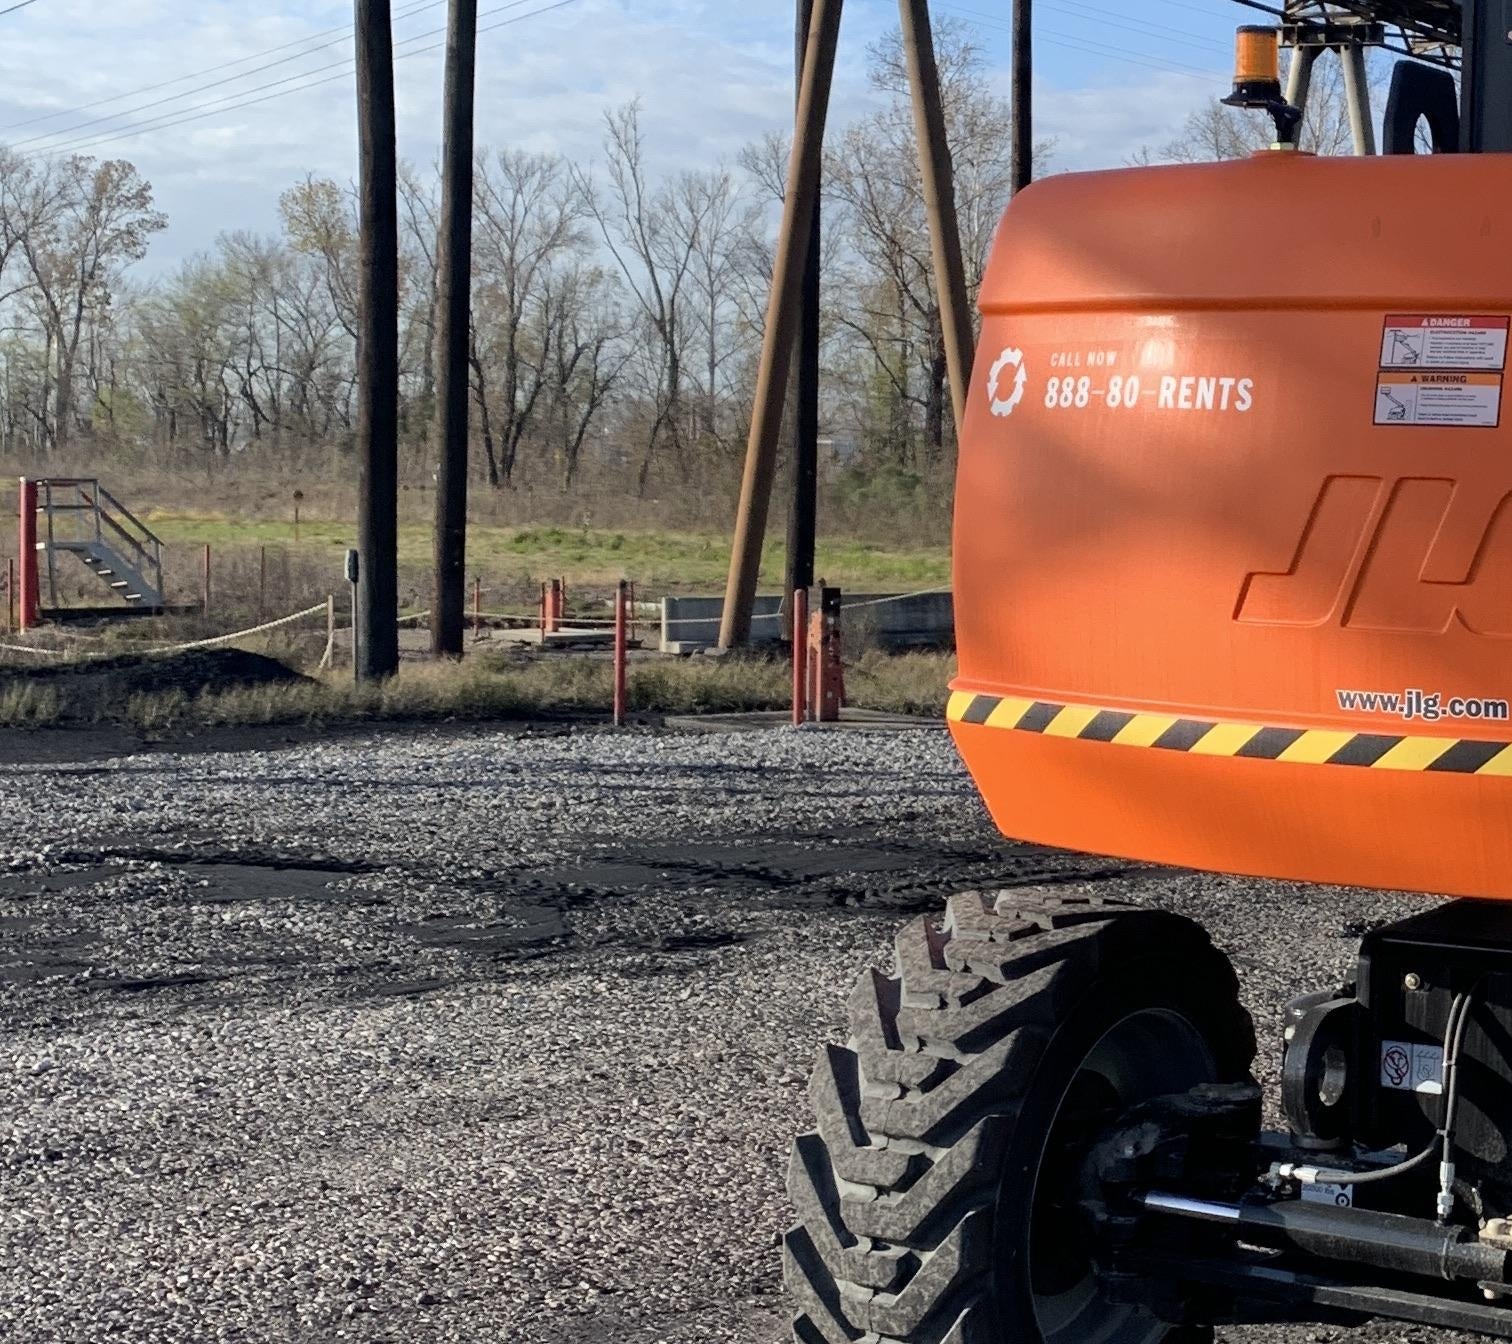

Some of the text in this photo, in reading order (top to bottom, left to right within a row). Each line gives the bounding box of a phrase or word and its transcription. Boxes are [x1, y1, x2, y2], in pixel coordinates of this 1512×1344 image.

[1429, 318, 1471, 327] DANGER
[1050, 351, 1118, 368] CALL NOW
[1421, 375, 1467, 384] WARNING
[1337, 688, 1509, 722] www.jlg.com
